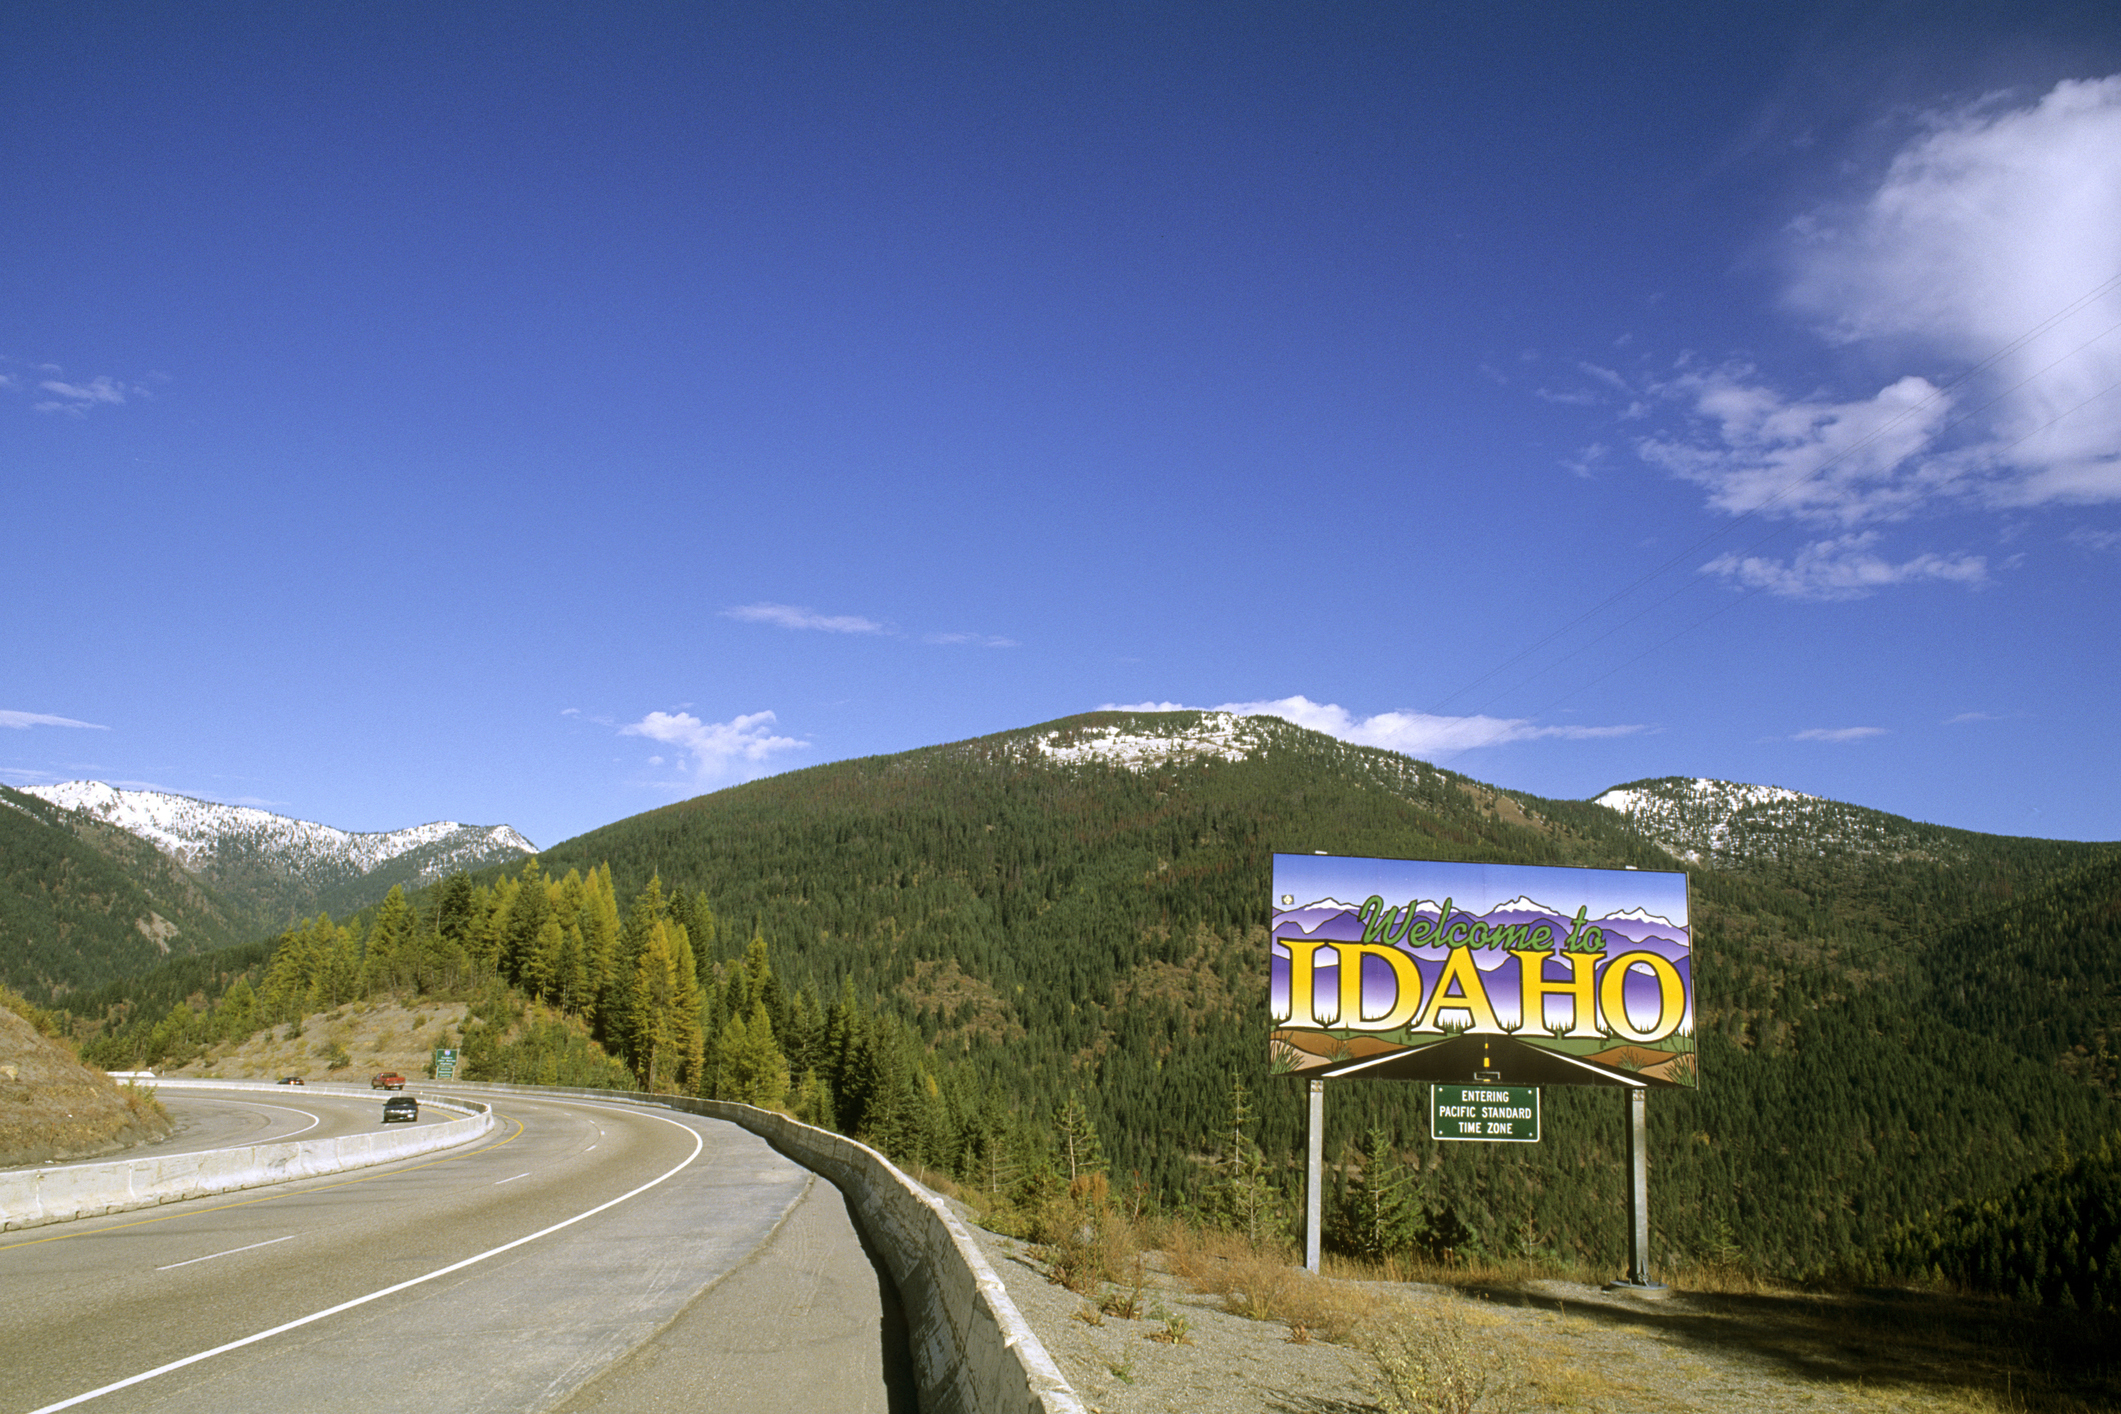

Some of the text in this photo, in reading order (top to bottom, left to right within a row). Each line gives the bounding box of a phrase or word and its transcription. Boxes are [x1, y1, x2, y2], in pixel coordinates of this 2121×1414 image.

[1358, 895, 1607, 953] Welcome to
[1277, 937, 1686, 1043] IDAHO
[1461, 1090, 1509, 1103] ENTERING
[1439, 1105, 1532, 1119] PACIFIC STANDARD
[1458, 1121, 1513, 1134] TIME ZONE
